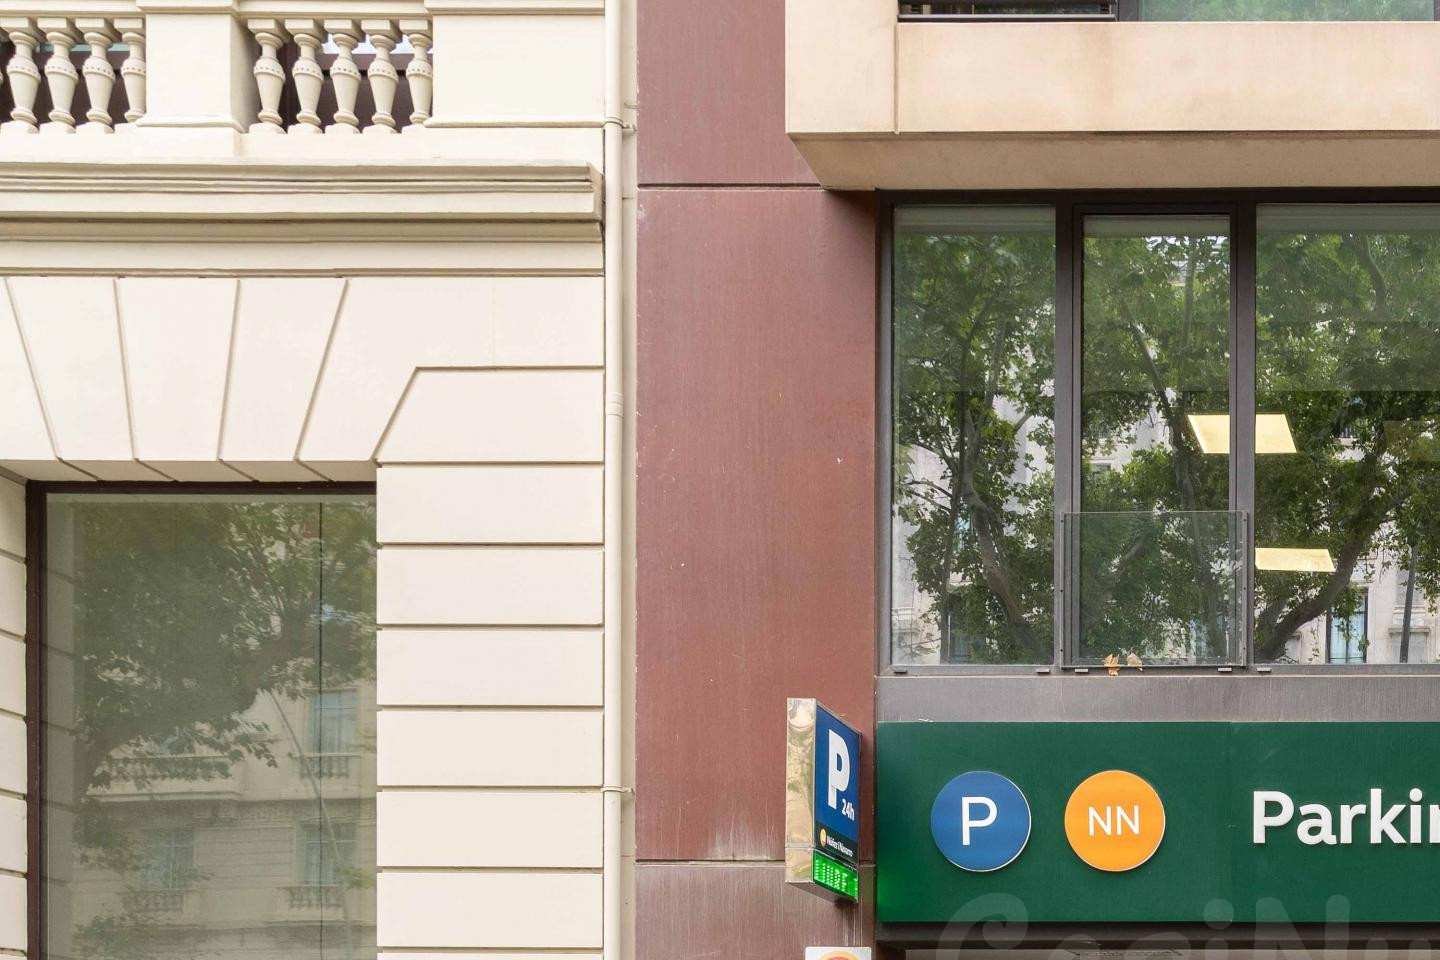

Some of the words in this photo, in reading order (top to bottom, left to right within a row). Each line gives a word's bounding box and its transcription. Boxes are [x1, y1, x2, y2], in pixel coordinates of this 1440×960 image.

[828, 728, 850, 809] P
[961, 796, 999, 846] P
[1088, 805, 1141, 836] NN
